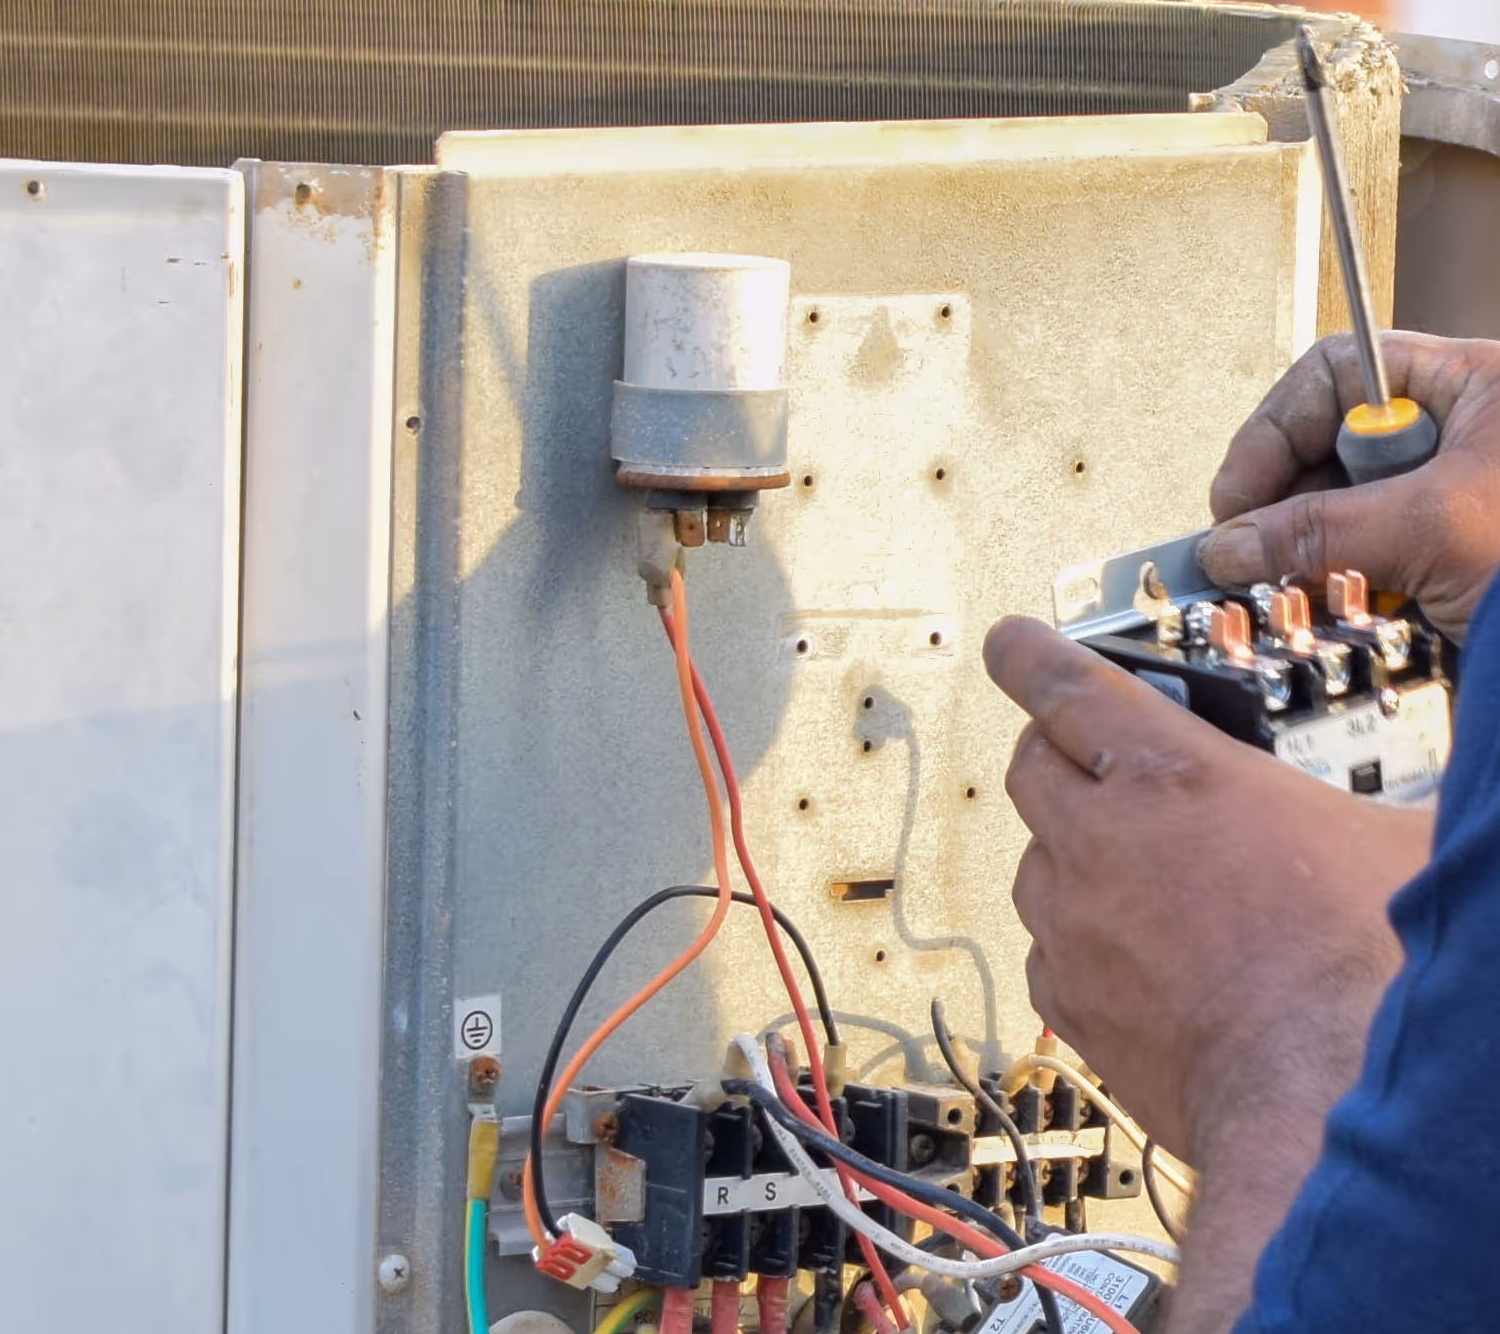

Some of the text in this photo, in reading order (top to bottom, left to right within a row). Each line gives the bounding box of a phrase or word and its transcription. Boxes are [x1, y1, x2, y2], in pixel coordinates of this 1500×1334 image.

[717, 1181, 777, 1205] R S
[989, 1314, 1005, 1332] T2
